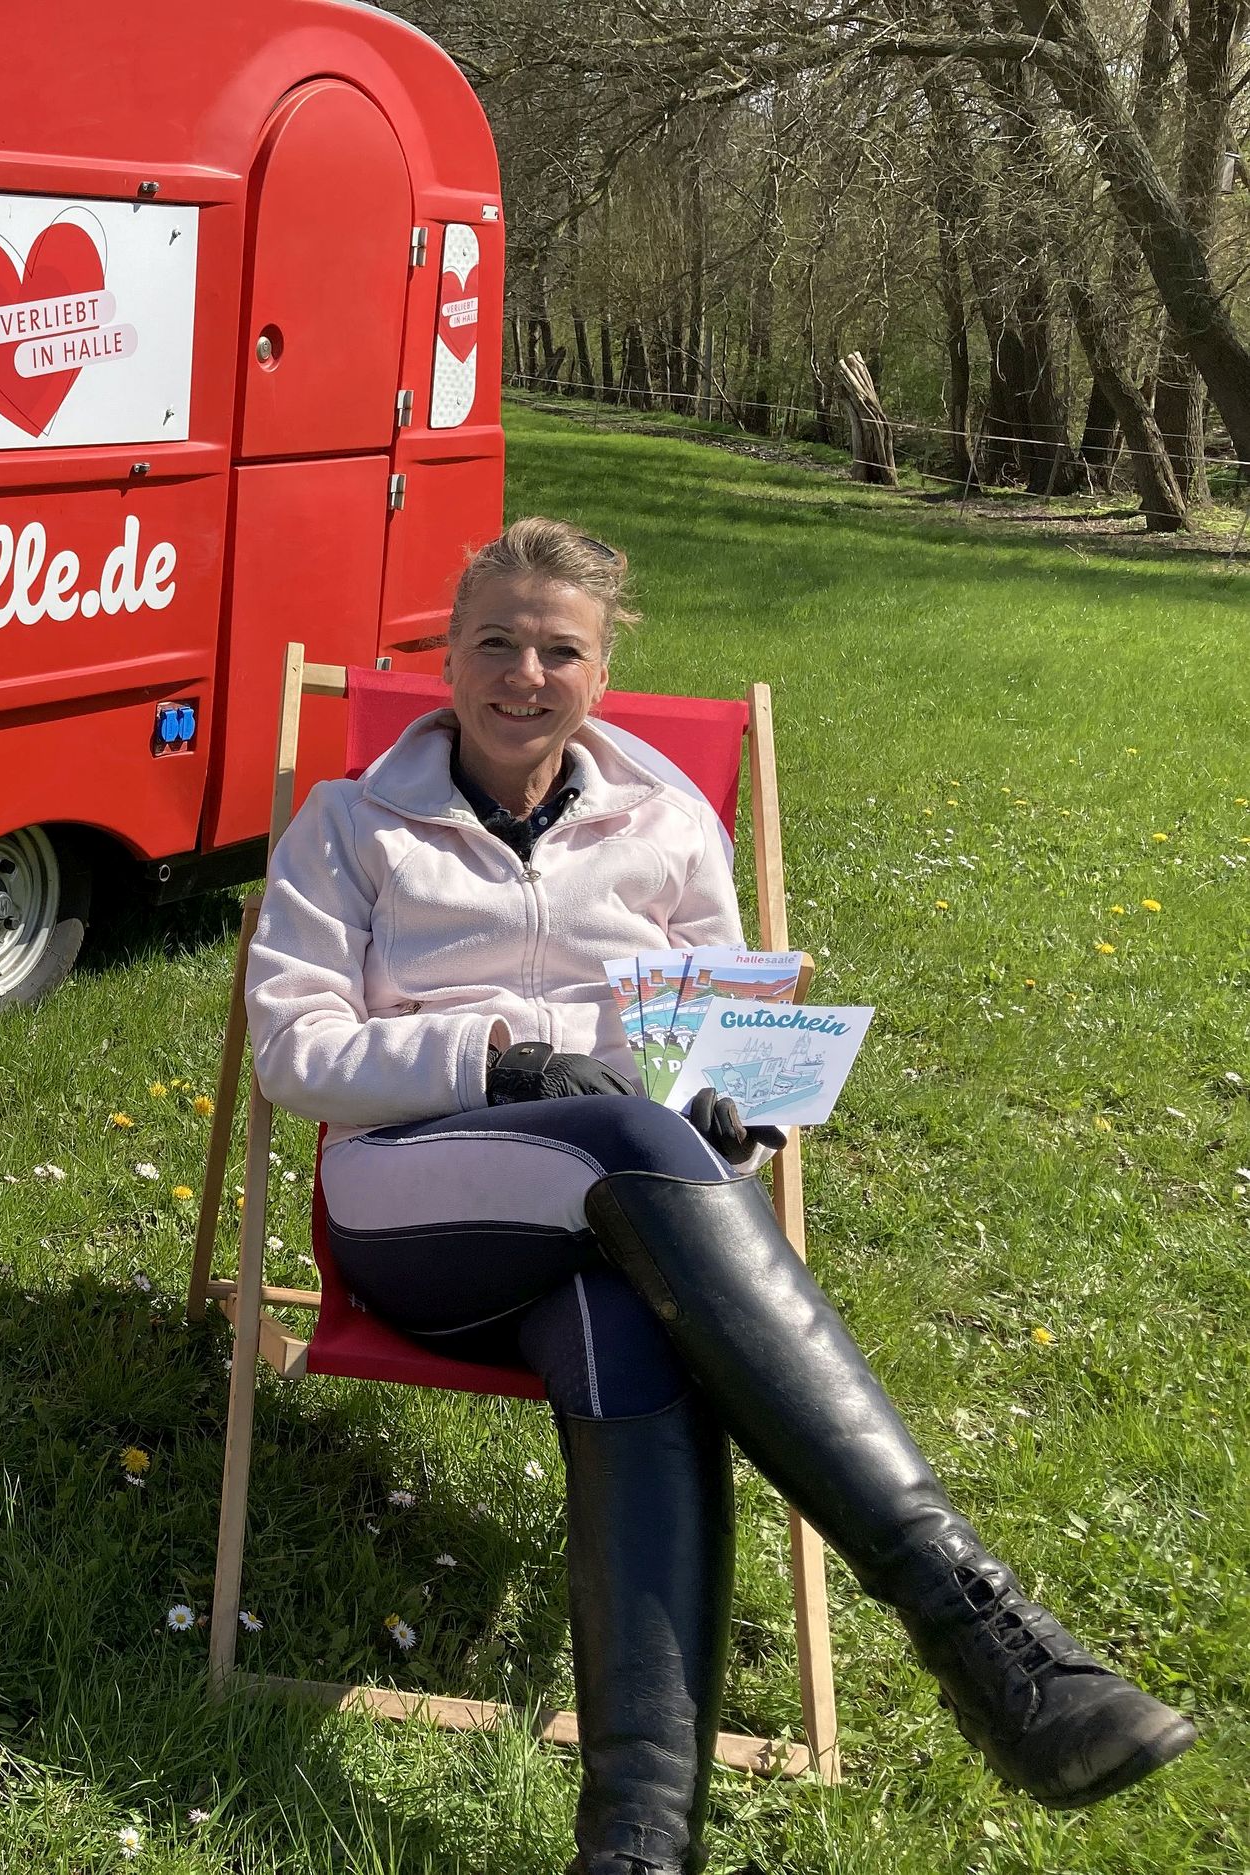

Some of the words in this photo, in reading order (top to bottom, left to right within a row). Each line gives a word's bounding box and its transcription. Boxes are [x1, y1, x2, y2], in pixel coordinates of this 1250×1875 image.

[0, 298, 99, 336] VERLIEBT
[447, 300, 474, 313] VERLIEBT
[453, 315, 460, 324] IN
[32, 344, 54, 369] IN
[63, 332, 123, 363] HALLE
[735, 954, 798, 965] hallesaale
[720, 1008, 851, 1037] Gutschein
